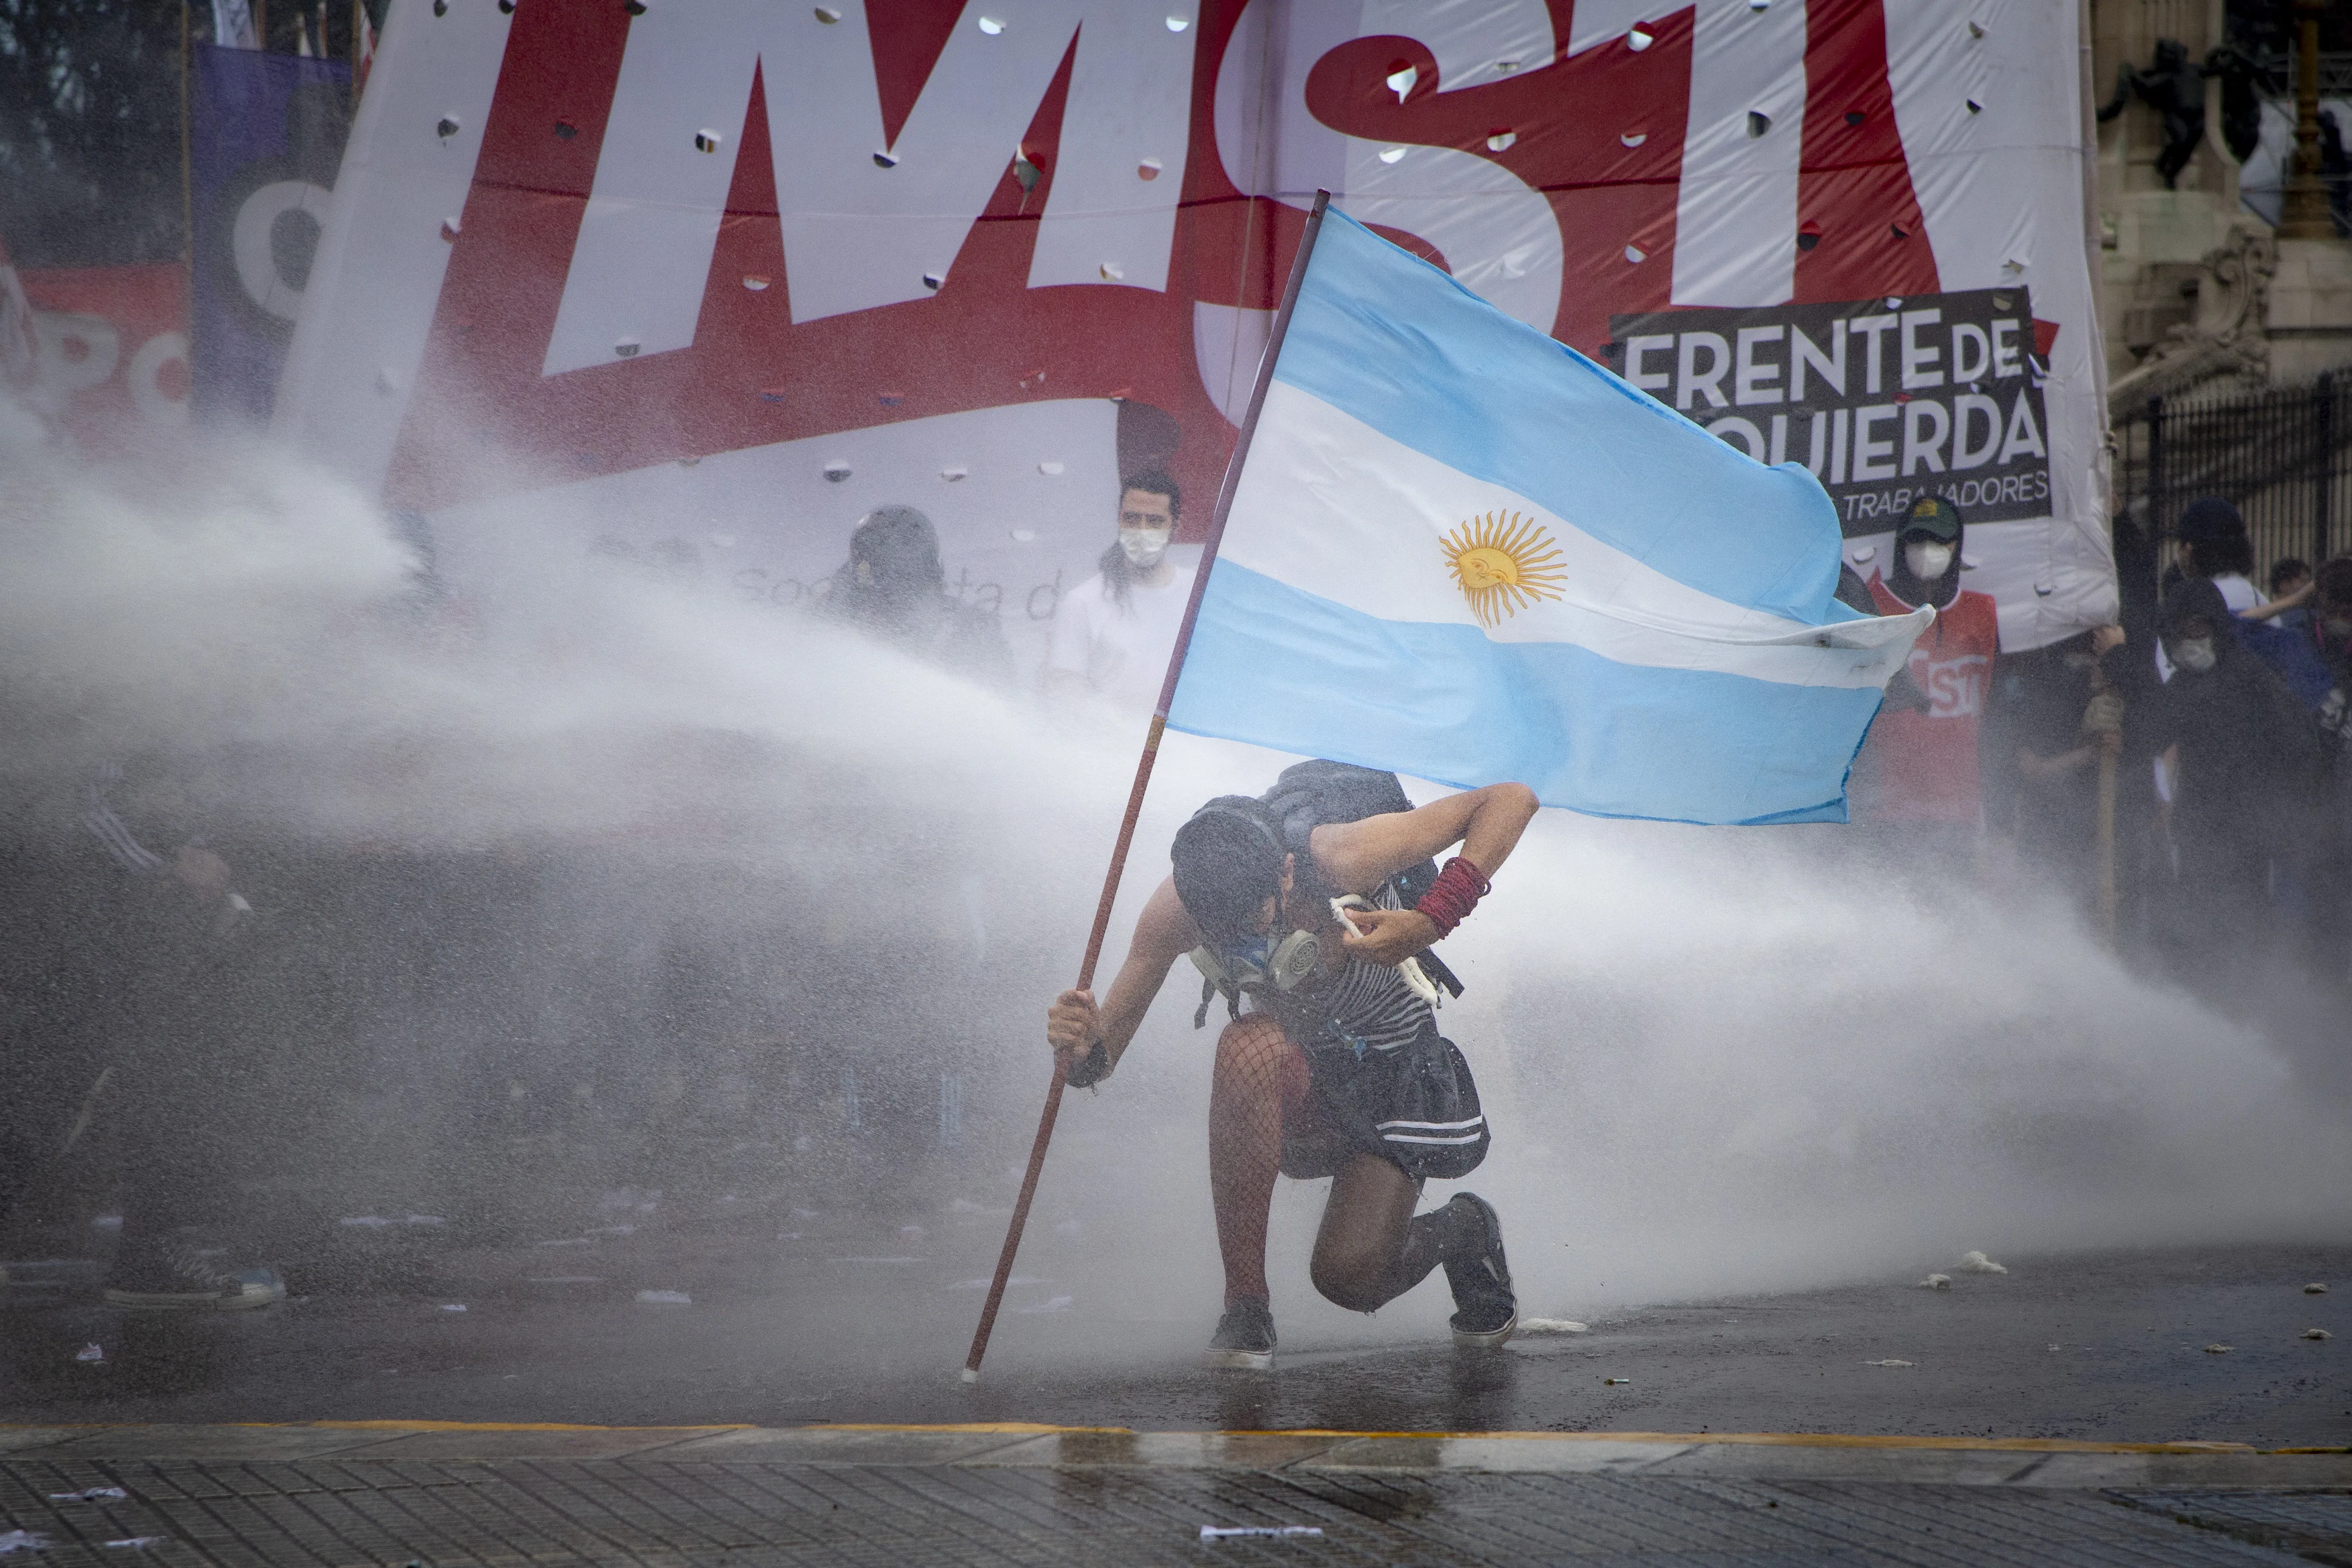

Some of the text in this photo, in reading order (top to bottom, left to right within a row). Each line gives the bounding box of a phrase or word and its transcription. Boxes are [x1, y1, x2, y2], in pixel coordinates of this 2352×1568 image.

[1624, 308, 2022, 410] FRENTE DE
[1843, 471, 2048, 521] TRABADORES
